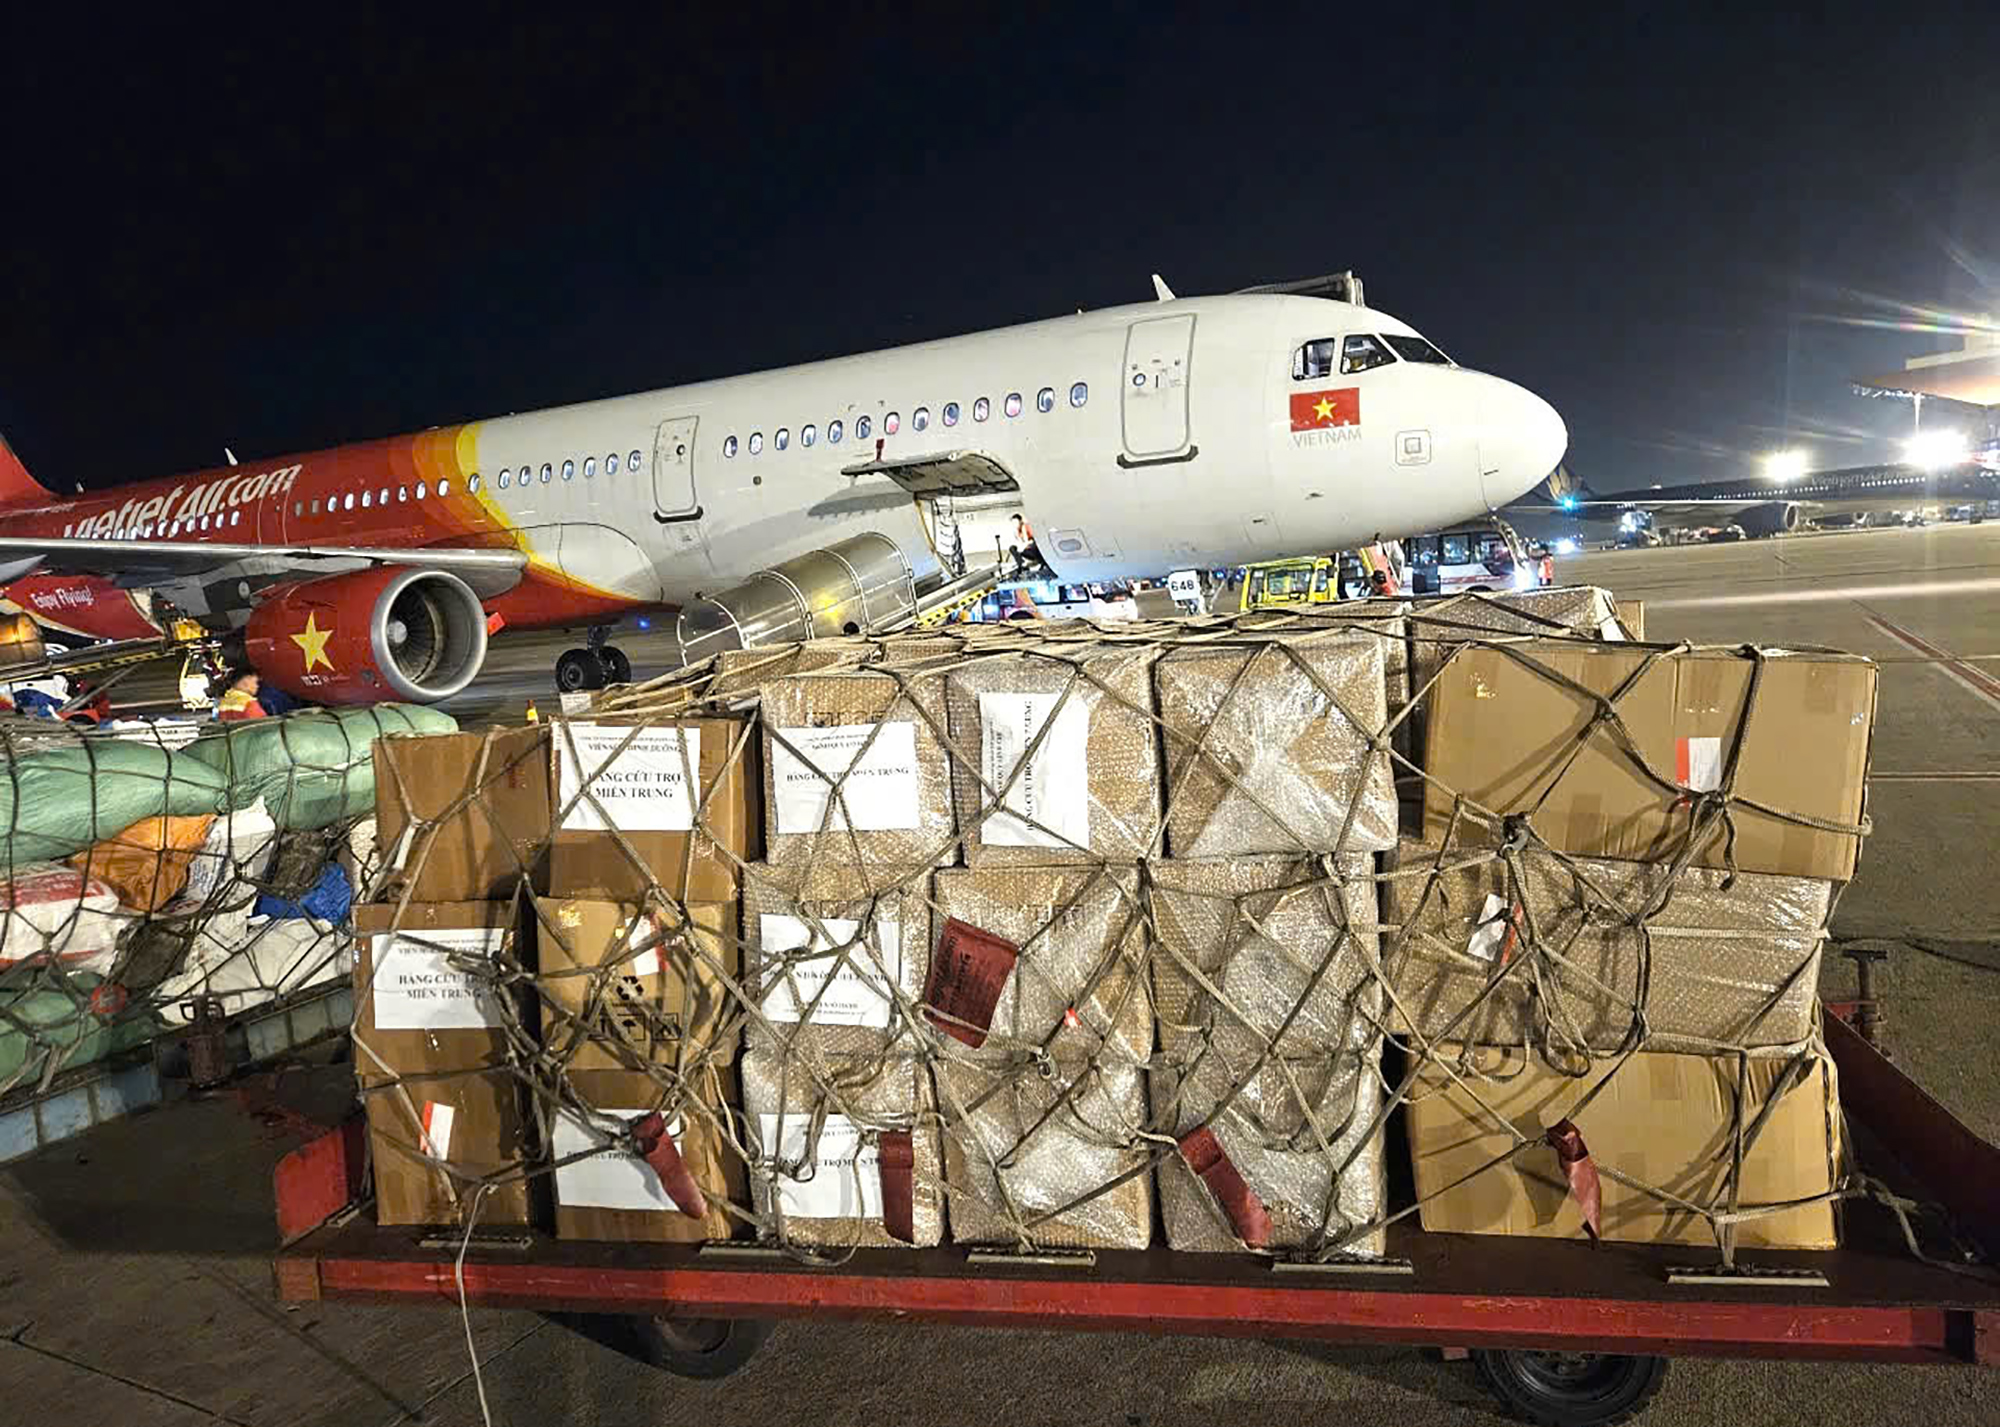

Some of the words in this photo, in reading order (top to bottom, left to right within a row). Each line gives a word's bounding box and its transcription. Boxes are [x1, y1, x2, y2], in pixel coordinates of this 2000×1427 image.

[1293, 427, 1362, 448] VIETNAM
[1171, 579, 1194, 591] 648
[631, 787, 673, 798] TRUNG
